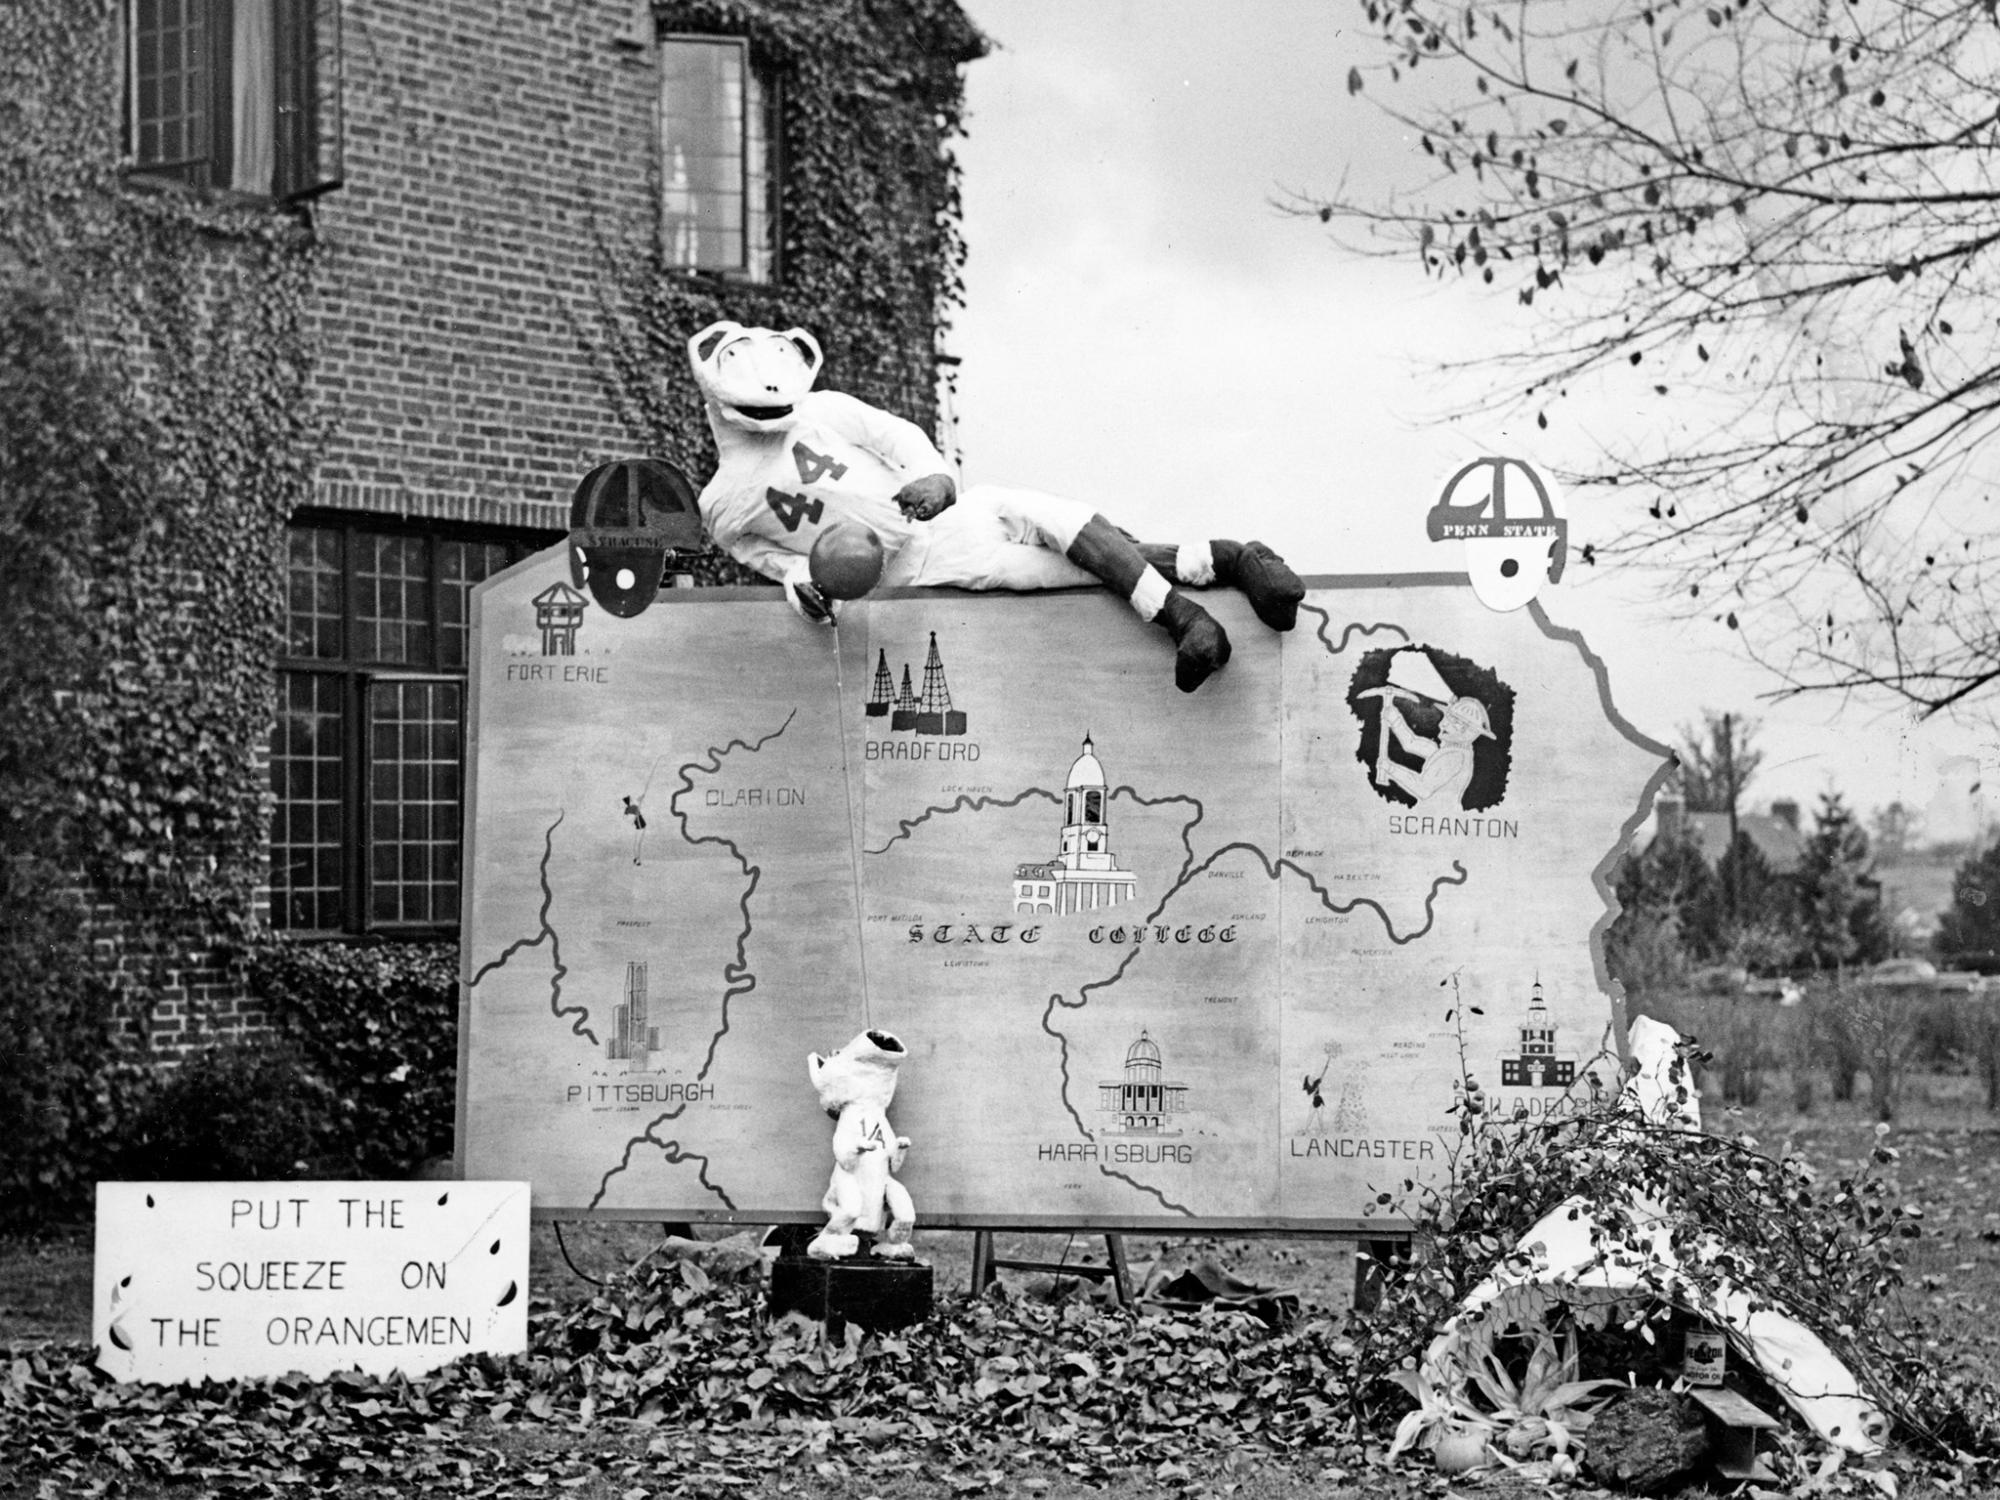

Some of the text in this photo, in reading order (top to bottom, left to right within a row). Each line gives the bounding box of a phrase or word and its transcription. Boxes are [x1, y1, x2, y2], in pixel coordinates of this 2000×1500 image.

[1443, 525, 1557, 537] PENN STATE
[507, 664, 608, 683] FORT ERIE
[865, 741, 980, 762] BRADFORD
[706, 787, 805, 807] CLARION
[1389, 815, 1519, 838] SCRANTON
[908, 924, 1237, 945] STATE COLLEGE
[567, 1084, 714, 1102] PITTSBURGH
[1038, 1144, 1192, 1163] HARRISBURG
[1291, 1138, 1434, 1161] LANCASTER
[231, 1199, 405, 1230] PUT THE
[196, 1261, 447, 1292] SQUEEZE ON
[150, 1316, 472, 1347] THE ORANGEMEN
